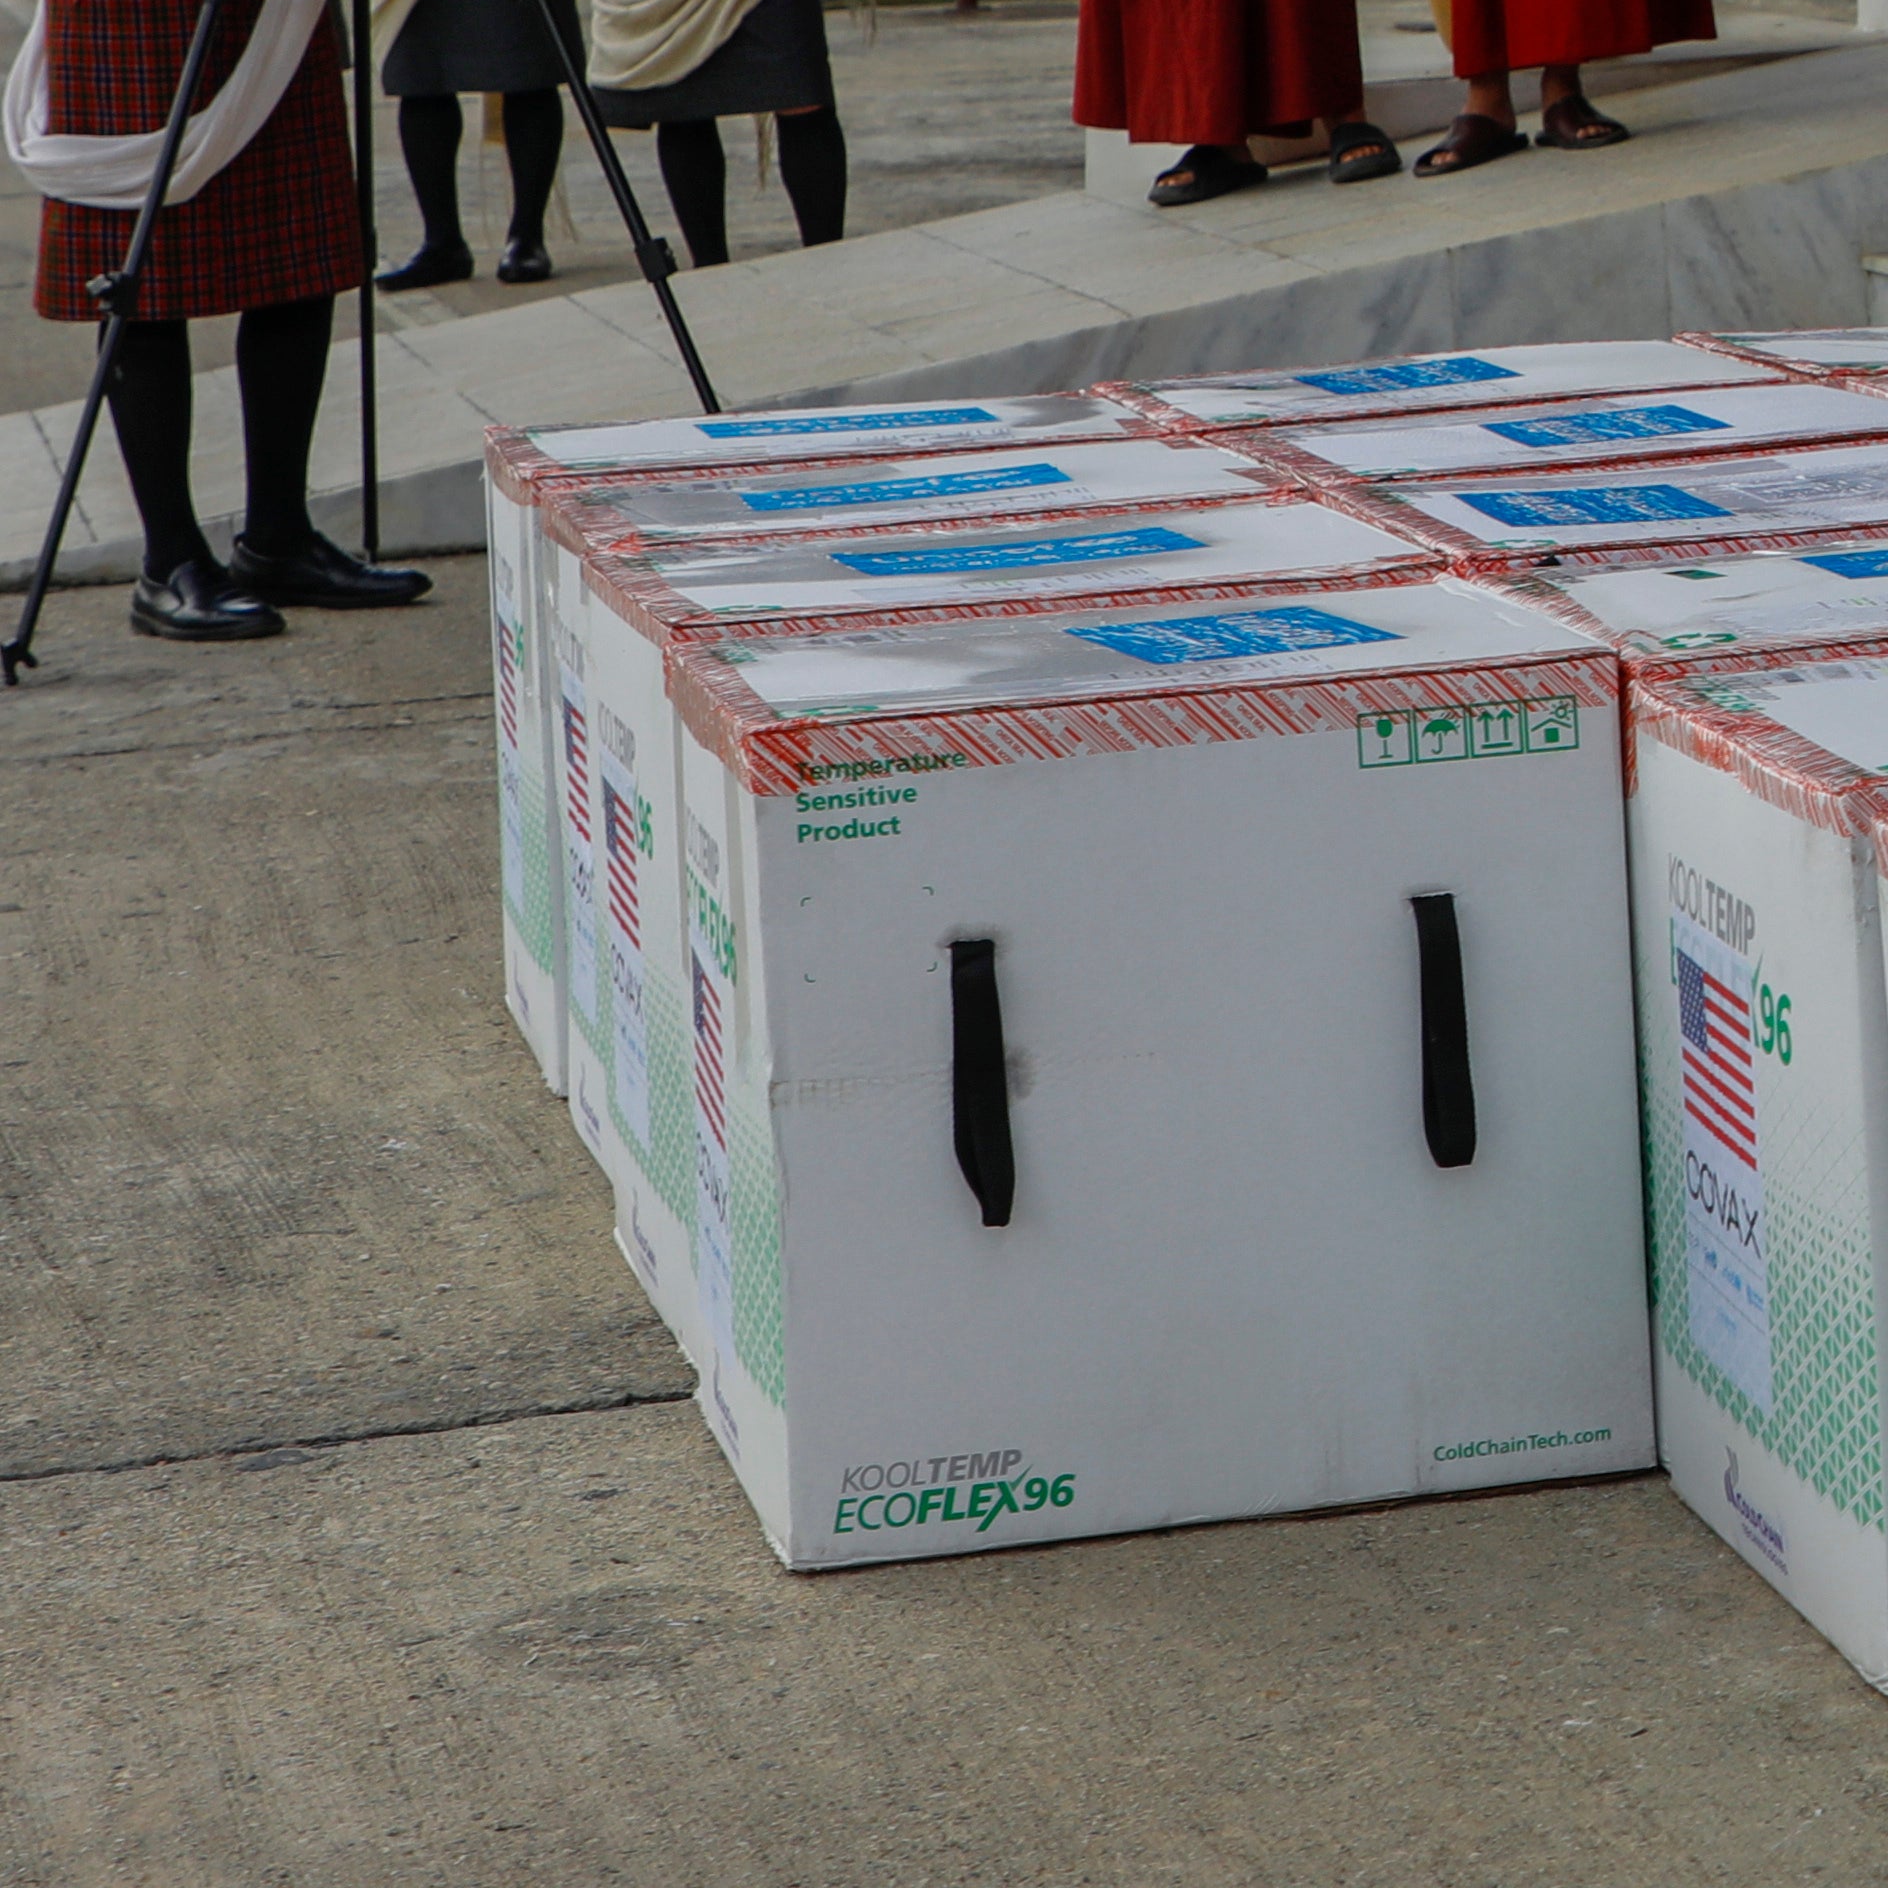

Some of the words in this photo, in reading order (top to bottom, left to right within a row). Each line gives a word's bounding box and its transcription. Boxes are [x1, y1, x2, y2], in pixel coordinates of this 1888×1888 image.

[795, 751, 967, 781] Temperature
[795, 785, 918, 813] Sensitive
[797, 816, 902, 843] Product
[1667, 852, 1756, 956] KOOLTEMP
[1685, 1149, 1762, 1259] COVAX
[1433, 1428, 1612, 1462] ColdChainTech.com
[841, 1449, 1023, 1494] KOOLTEMP
[834, 1466, 1076, 1534] ECOFLEX96
